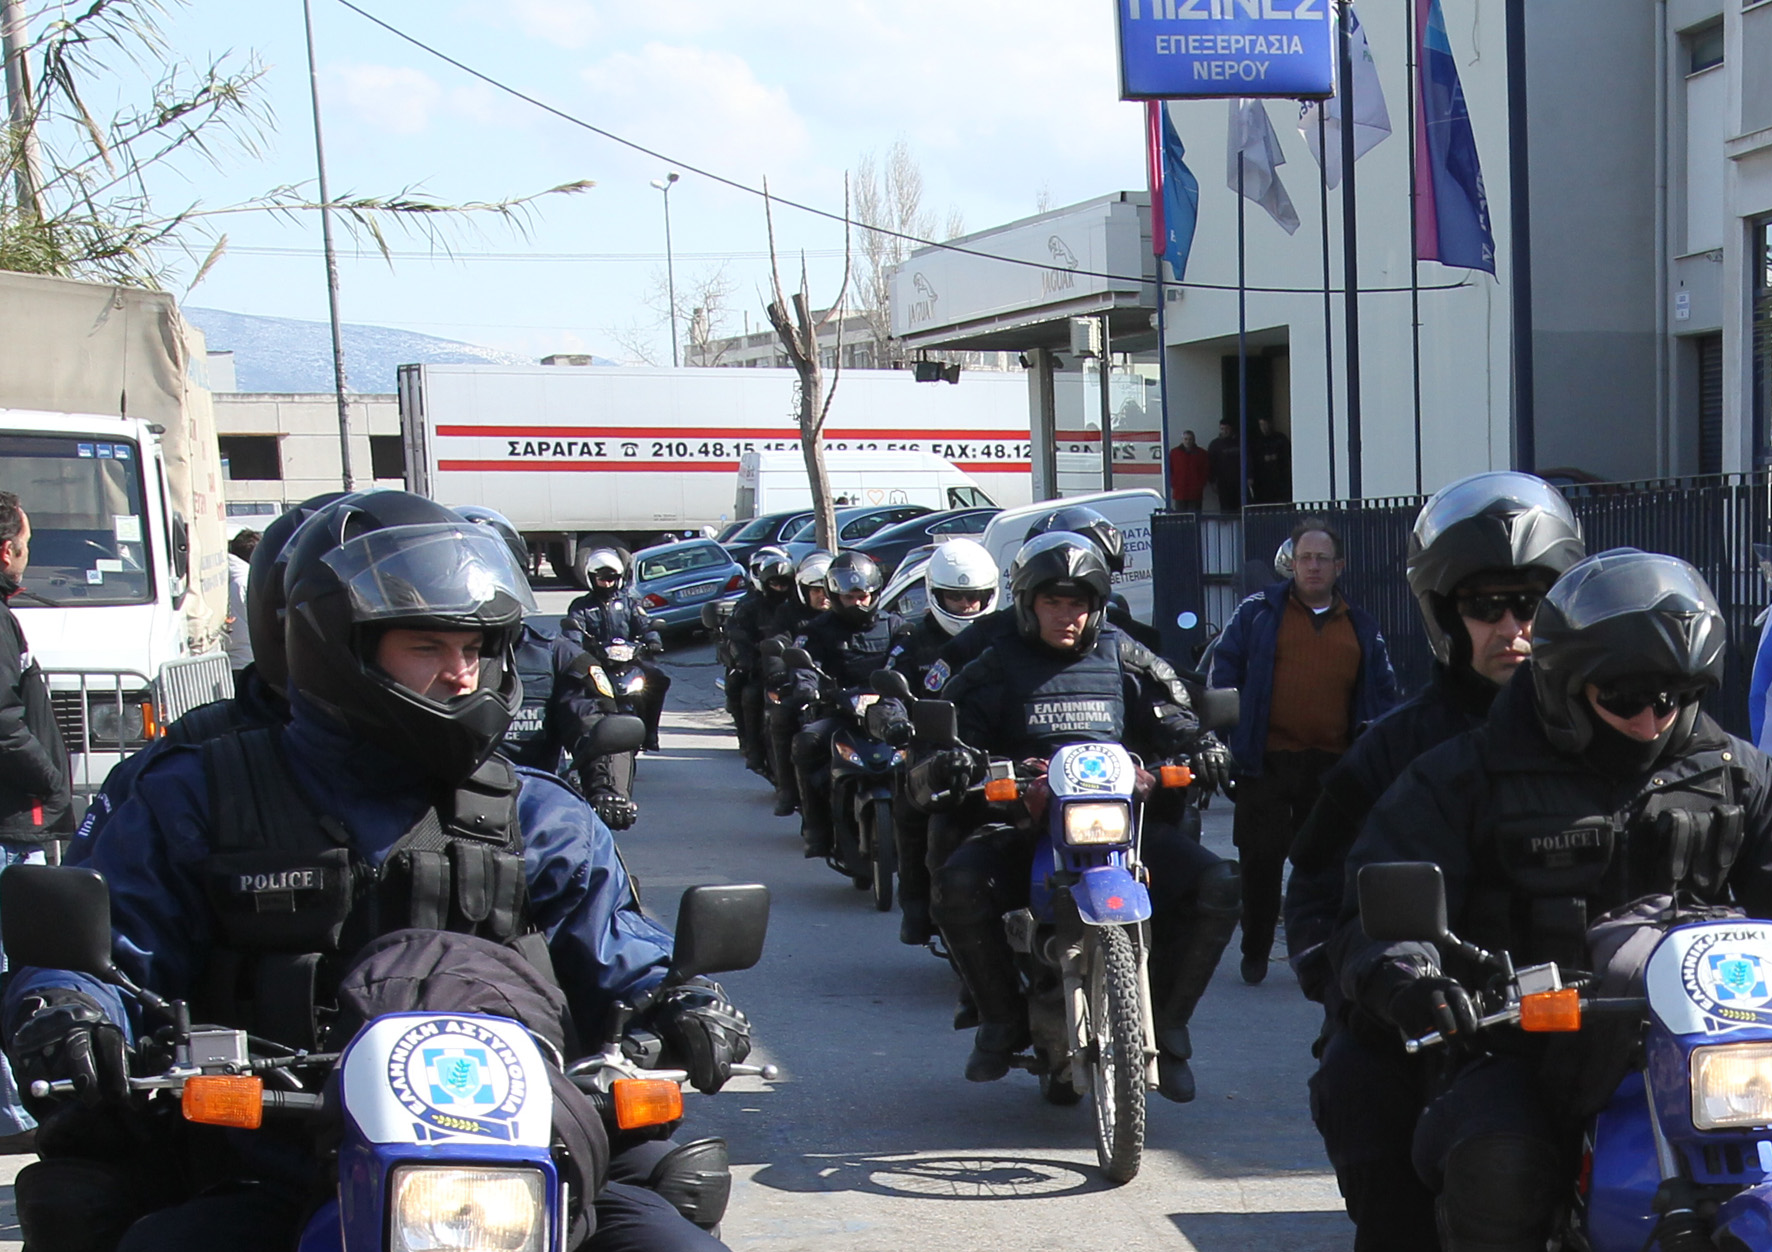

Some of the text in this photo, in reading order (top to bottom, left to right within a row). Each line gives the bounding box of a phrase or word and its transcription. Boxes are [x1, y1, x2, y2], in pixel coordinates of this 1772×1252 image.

[1155, 35, 1304, 55] ΕΠΕΞΕΡΓΑΣΙΑ
[1193, 60, 1270, 81] ΝΕΡΟΥ
[508, 441, 607, 457] ΣΑΡΑΓΑΣ
[1110, 570, 1153, 585] BETTERMA
[1034, 701, 1105, 714] ΕΛΛΗΝΙΚΗ
[1028, 712, 1112, 725] ΑΣΤΥΝΟΜΙΑ
[1051, 722, 1091, 731] POLICE
[1531, 832, 1592, 852] POLICE
[240, 871, 313, 891] POLICE
[390, 1020, 523, 1116] ΕΛΛΗΝΙΚΗ ΑΣΤΥΝΟΜΙΑ
